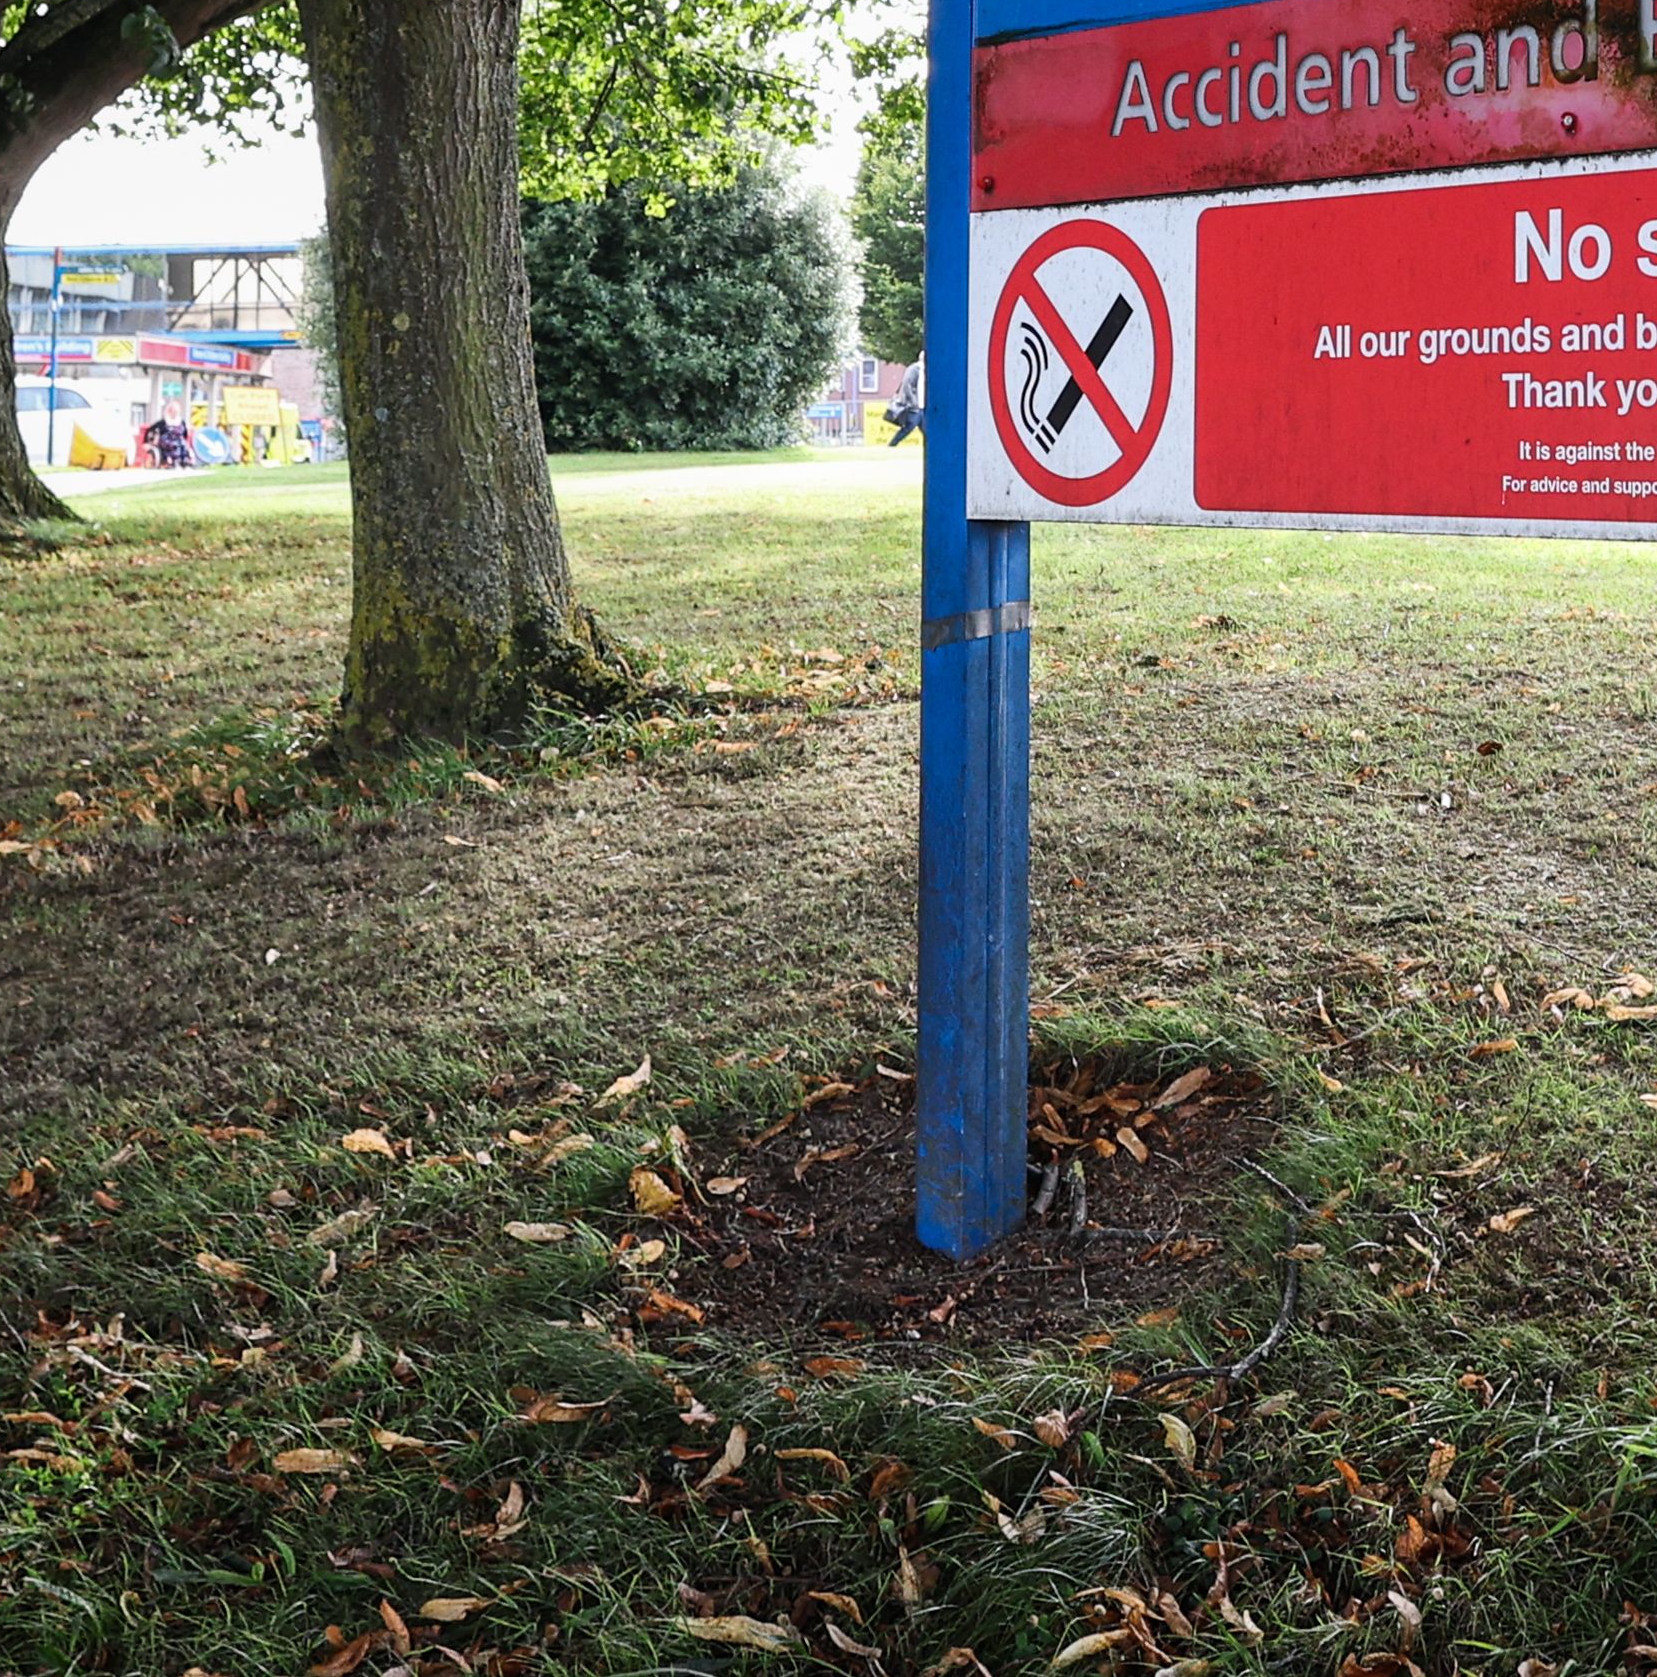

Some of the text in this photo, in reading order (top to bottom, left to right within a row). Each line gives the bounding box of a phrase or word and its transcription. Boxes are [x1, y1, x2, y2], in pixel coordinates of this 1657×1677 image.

[1110, 27, 1418, 137] Accident
[1514, 208, 1612, 283] No
[1313, 324, 1351, 358] All
[1359, 330, 1411, 358] our
[1418, 317, 1551, 364] grounds
[1560, 313, 1625, 352] and
[1501, 370, 1606, 409] Thank
[1519, 441, 1532, 461] It
[1535, 441, 1551, 461] is
[1555, 441, 1621, 465] against
[1625, 441, 1655, 462] the
[1502, 475, 1527, 492] For
[1530, 476, 1578, 493] advice
[1581, 477, 1610, 494] and
